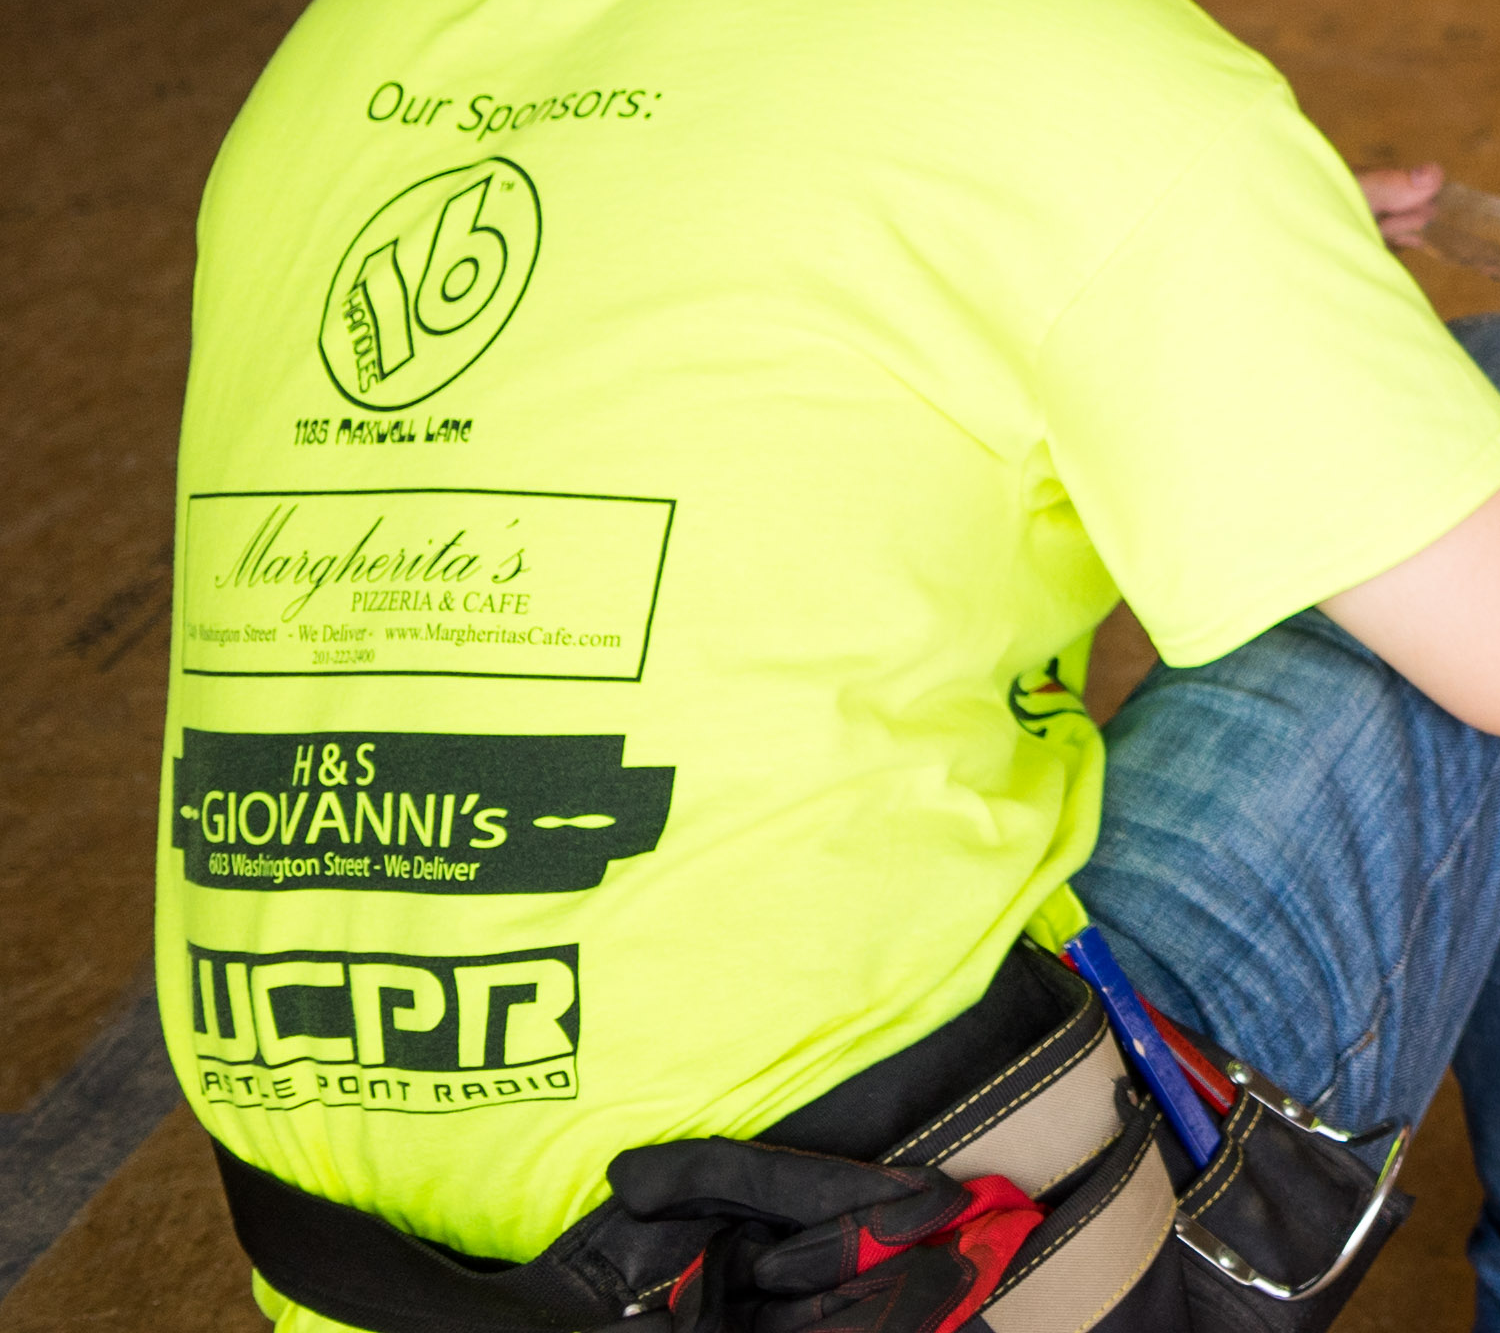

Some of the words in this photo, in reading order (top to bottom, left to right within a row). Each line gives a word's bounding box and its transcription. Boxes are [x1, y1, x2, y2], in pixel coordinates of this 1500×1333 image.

[368, 82, 453, 126] Our
[457, 89, 662, 142] Sponsors:
[357, 173, 511, 381] 16
[342, 290, 381, 394] HANDLES
[293, 416, 330, 446] 1185
[336, 418, 417, 445] MAXWELL
[215, 503, 531, 623] Margherita's
[350, 590, 432, 612] PIZZERIA
[439, 591, 456, 612] &
[462, 591, 531, 615] CAFE
[242, 625, 277, 642] Street
[298, 624, 318, 643] We
[385, 623, 621, 649] www.MargheritasCafe.com
[292, 743, 314, 786] H
[318, 745, 348, 787] &
[355, 742, 376, 786] S
[201, 790, 508, 849] GIOVANNI's
[208, 852, 230, 876] 603
[231, 855, 319, 884] Washington
[324, 853, 371, 877] Street
[385, 857, 410, 877] We
[413, 856, 480, 881] Deliver
[194, 958, 576, 1070] WCPR
[434, 1070, 572, 1103] RADIO
